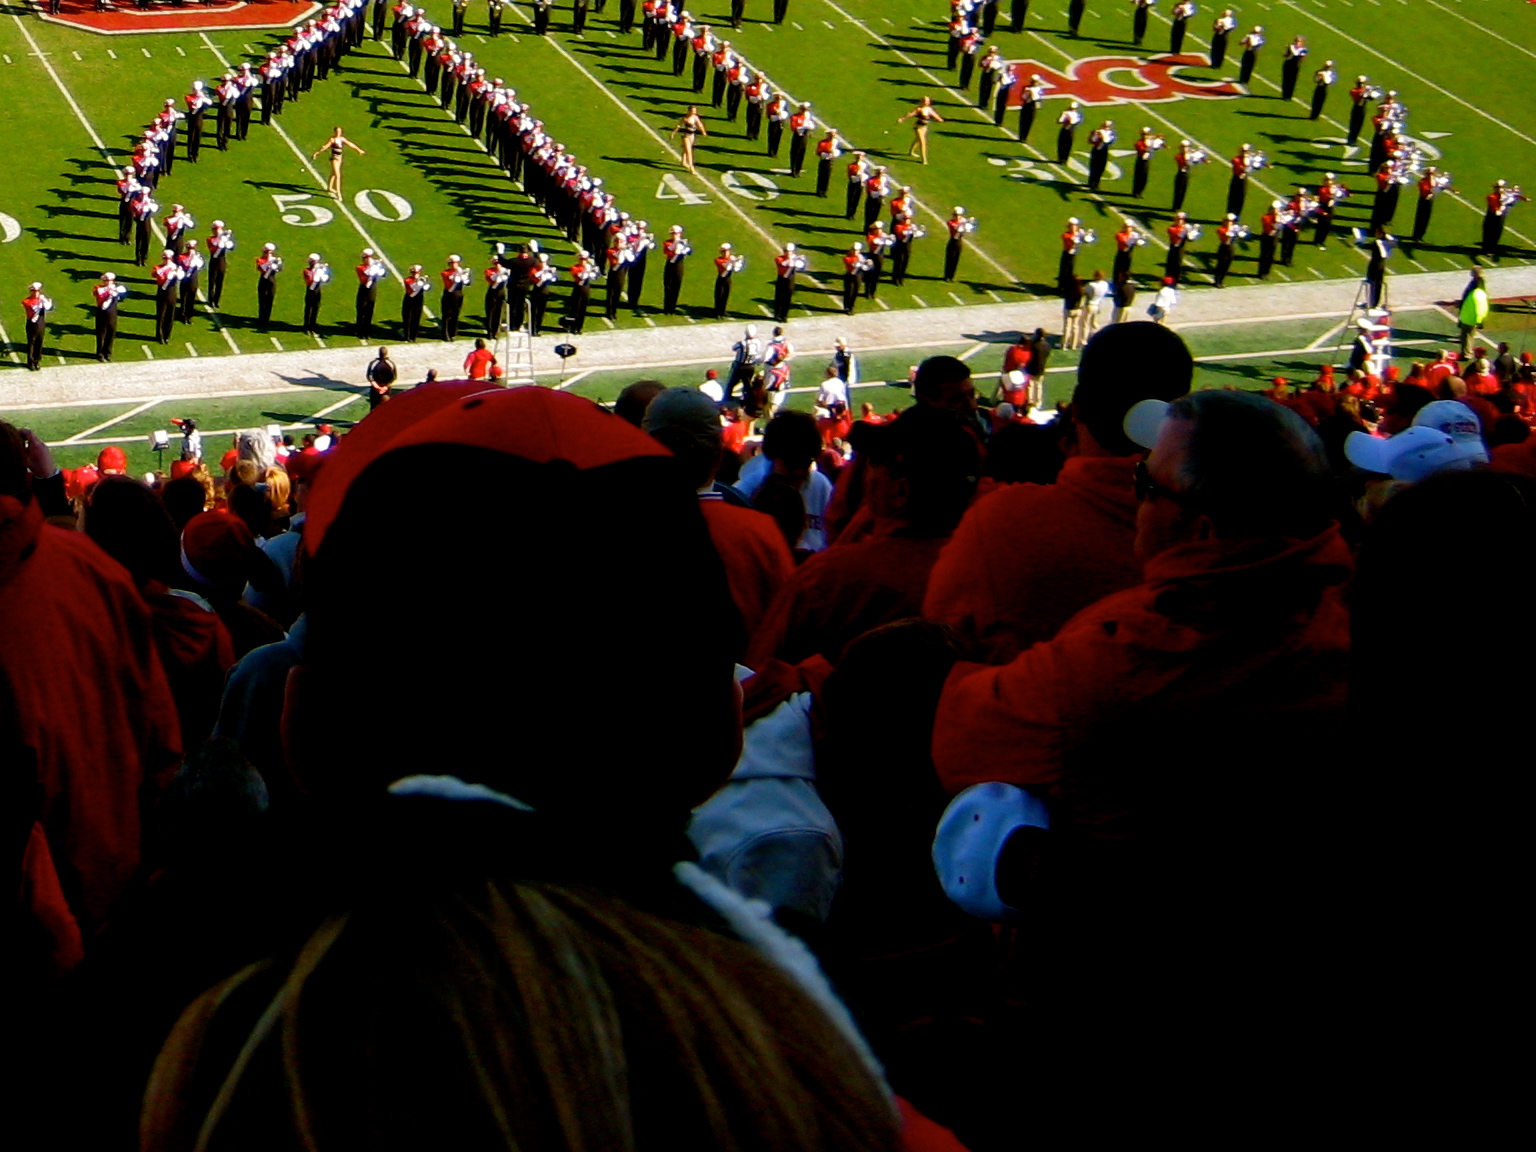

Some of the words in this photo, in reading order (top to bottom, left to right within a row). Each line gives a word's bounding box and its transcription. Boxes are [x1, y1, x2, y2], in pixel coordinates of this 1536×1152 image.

[992, 51, 1250, 110] ACC
[271, 188, 413, 228] 50
[656, 170, 780, 206] 40
